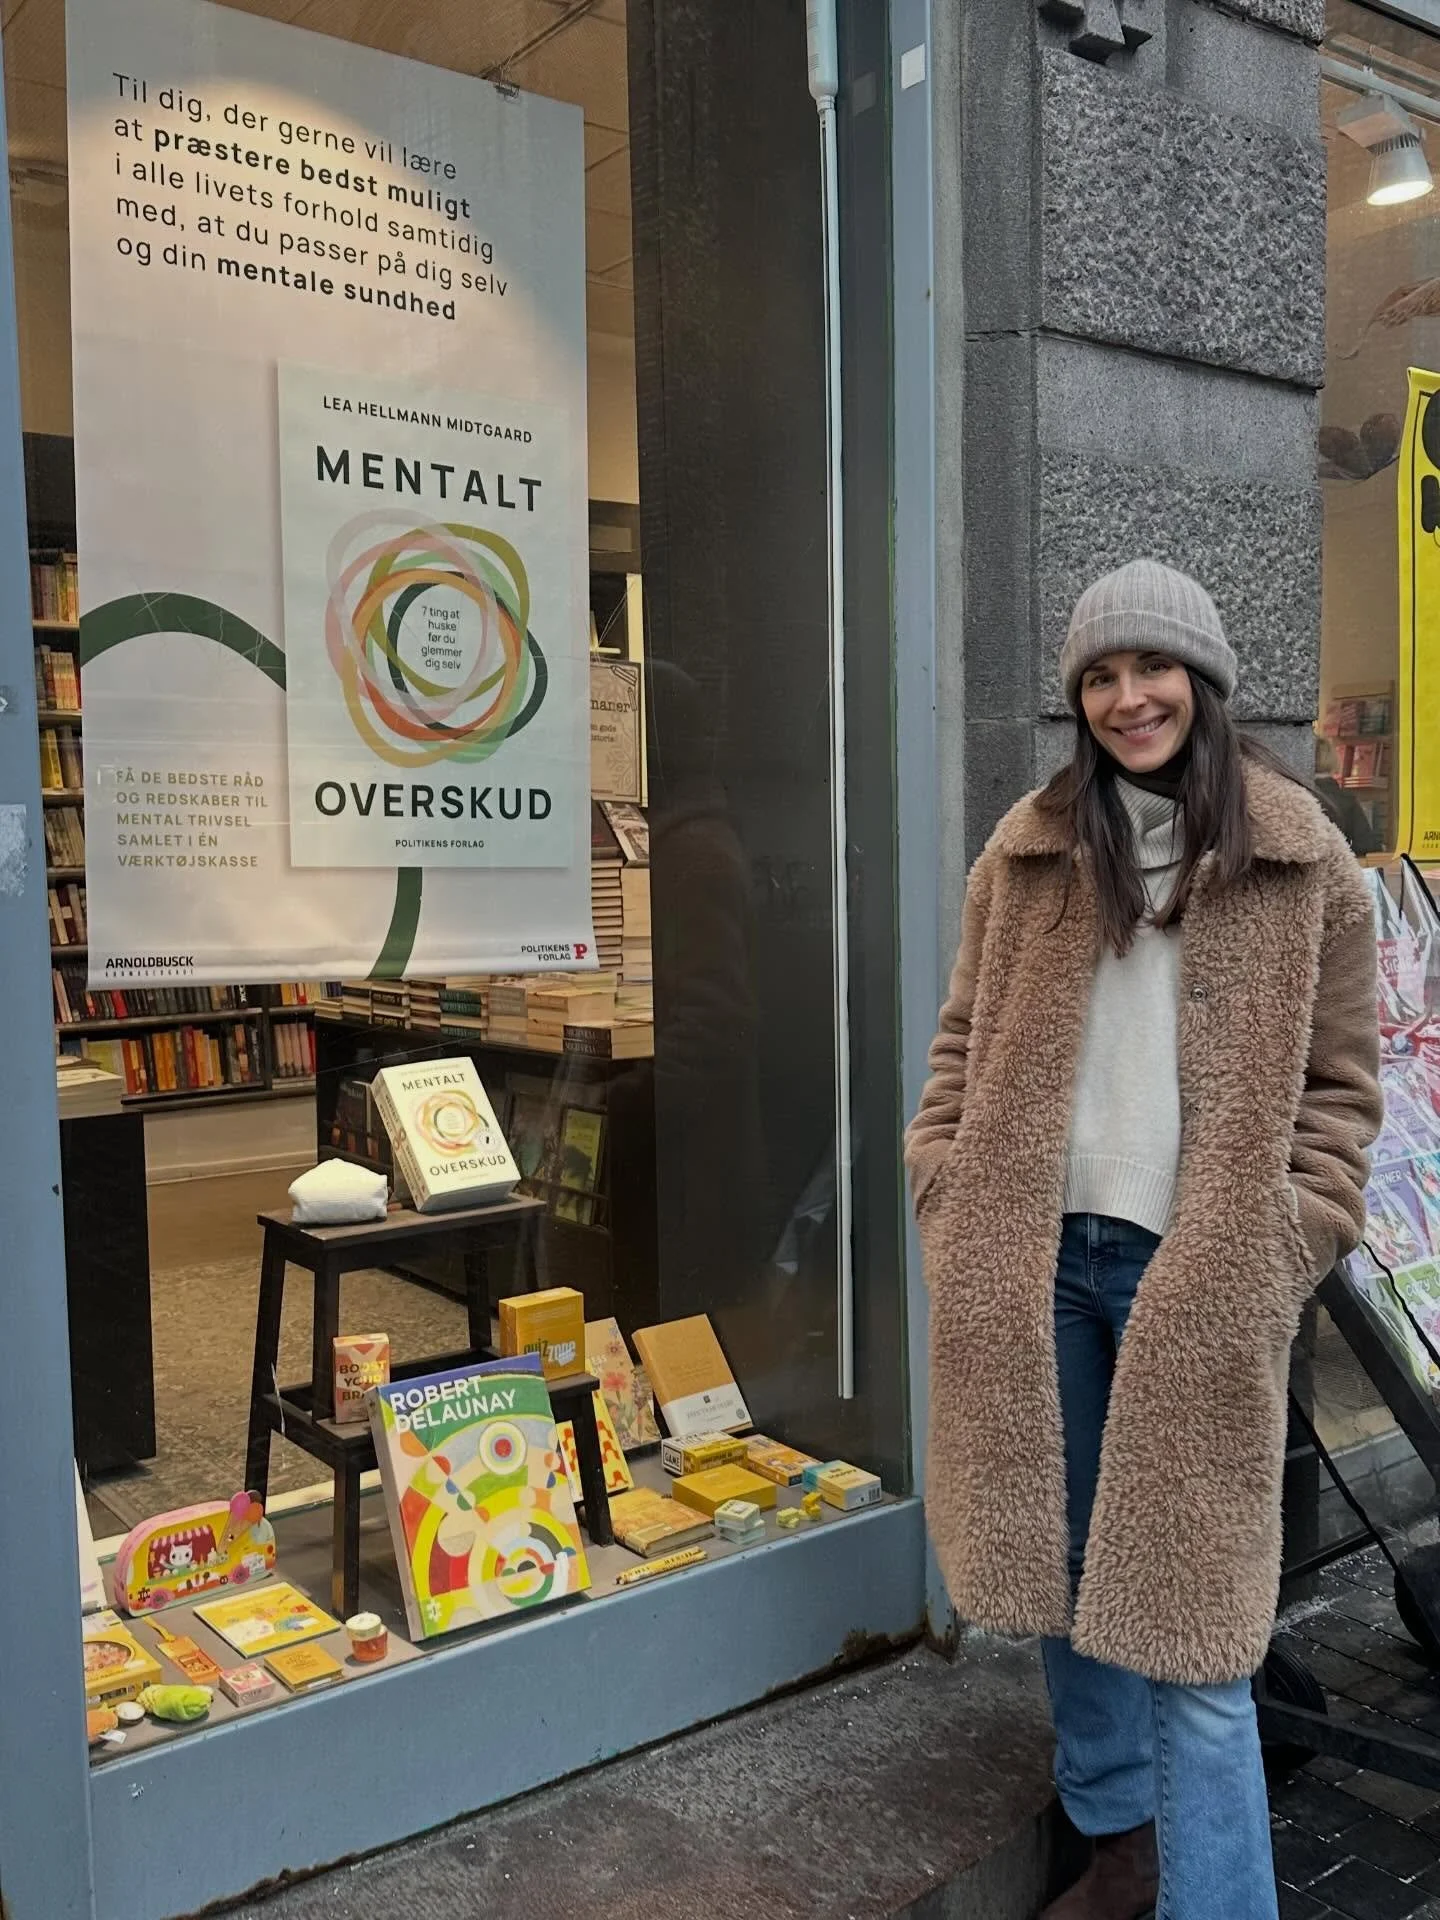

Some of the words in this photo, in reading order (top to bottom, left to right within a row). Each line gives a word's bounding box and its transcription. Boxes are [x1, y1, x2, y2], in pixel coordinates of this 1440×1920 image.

[113, 73, 147, 104] Til
[159, 89, 211, 123] dig,
[224, 104, 268, 133] der
[279, 120, 355, 155] gerne
[365, 139, 392, 164] vil
[403, 147, 457, 181] lære
[115, 115, 142, 142] at
[155, 126, 290, 176] præstere
[301, 158, 377, 197] bedst
[388, 180, 470, 220] muligt
[116, 153, 121, 175] i
[133, 158, 184, 190] alle
[195, 172, 273, 209] livets
[284, 192, 378, 234] forhold
[388, 217, 493, 264] samtidig
[117, 196, 184, 232] med,
[198, 212, 225, 237] at
[236, 220, 268, 246] du
[280, 232, 368, 267] passer
[378, 246, 406, 276] på
[416, 259, 452, 290] dig
[461, 270, 507, 298] selv
[118, 235, 151, 266] og
[163, 245, 205, 271] din
[217, 256, 334, 295] mentale
[344, 280, 455, 321] sundhed
[323, 395, 352, 413] LEA
[358, 401, 441, 428] HELLMANN
[447, 417, 532, 443] MIDTGAARD
[317, 445, 542, 512] MENTALT
[422, 606, 428, 616] 7
[430, 607, 448, 621] ting
[450, 610, 460, 620] at
[428, 620, 457, 632] huske
[428, 632, 441, 643] før
[443, 634, 456, 644] du
[421, 645, 463, 657] glemmer
[425, 658, 440, 671] dig
[442, 660, 461, 670] selv
[116, 767, 135, 785] FÅ
[141, 772, 161, 785] DE
[167, 772, 228, 787] BEDSTE
[233, 771, 264, 788] RÅD
[116, 792, 140, 805] OG
[146, 792, 240, 807] REDSKABER
[245, 795, 268, 808] TIL
[315, 781, 552, 820] OVERSKUD
[117, 813, 183, 826] MENTAL
[188, 814, 253, 828] TRIVSEL
[118, 834, 183, 847] SAMLET
[188, 835, 192, 847] I
[199, 832, 218, 847] ÉN
[395, 839, 448, 848] POLITIKENS
[450, 840, 485, 849] FORLAG
[118, 855, 259, 868] VÆRKTØJSKASSE
[521, 944, 570, 953] POLITIKENS
[105, 955, 194, 969] ARNOLDBUSCK
[538, 953, 571, 961] FORLAG
[402, 1073, 466, 1091] MENTALT
[429, 1155, 507, 1177] OVERSKUD
[340, 1361, 387, 1374] BOOST
[344, 1375, 382, 1387] YOUR
[390, 1375, 482, 1413] ROBERT
[395, 1389, 516, 1434] DELAUNAY
